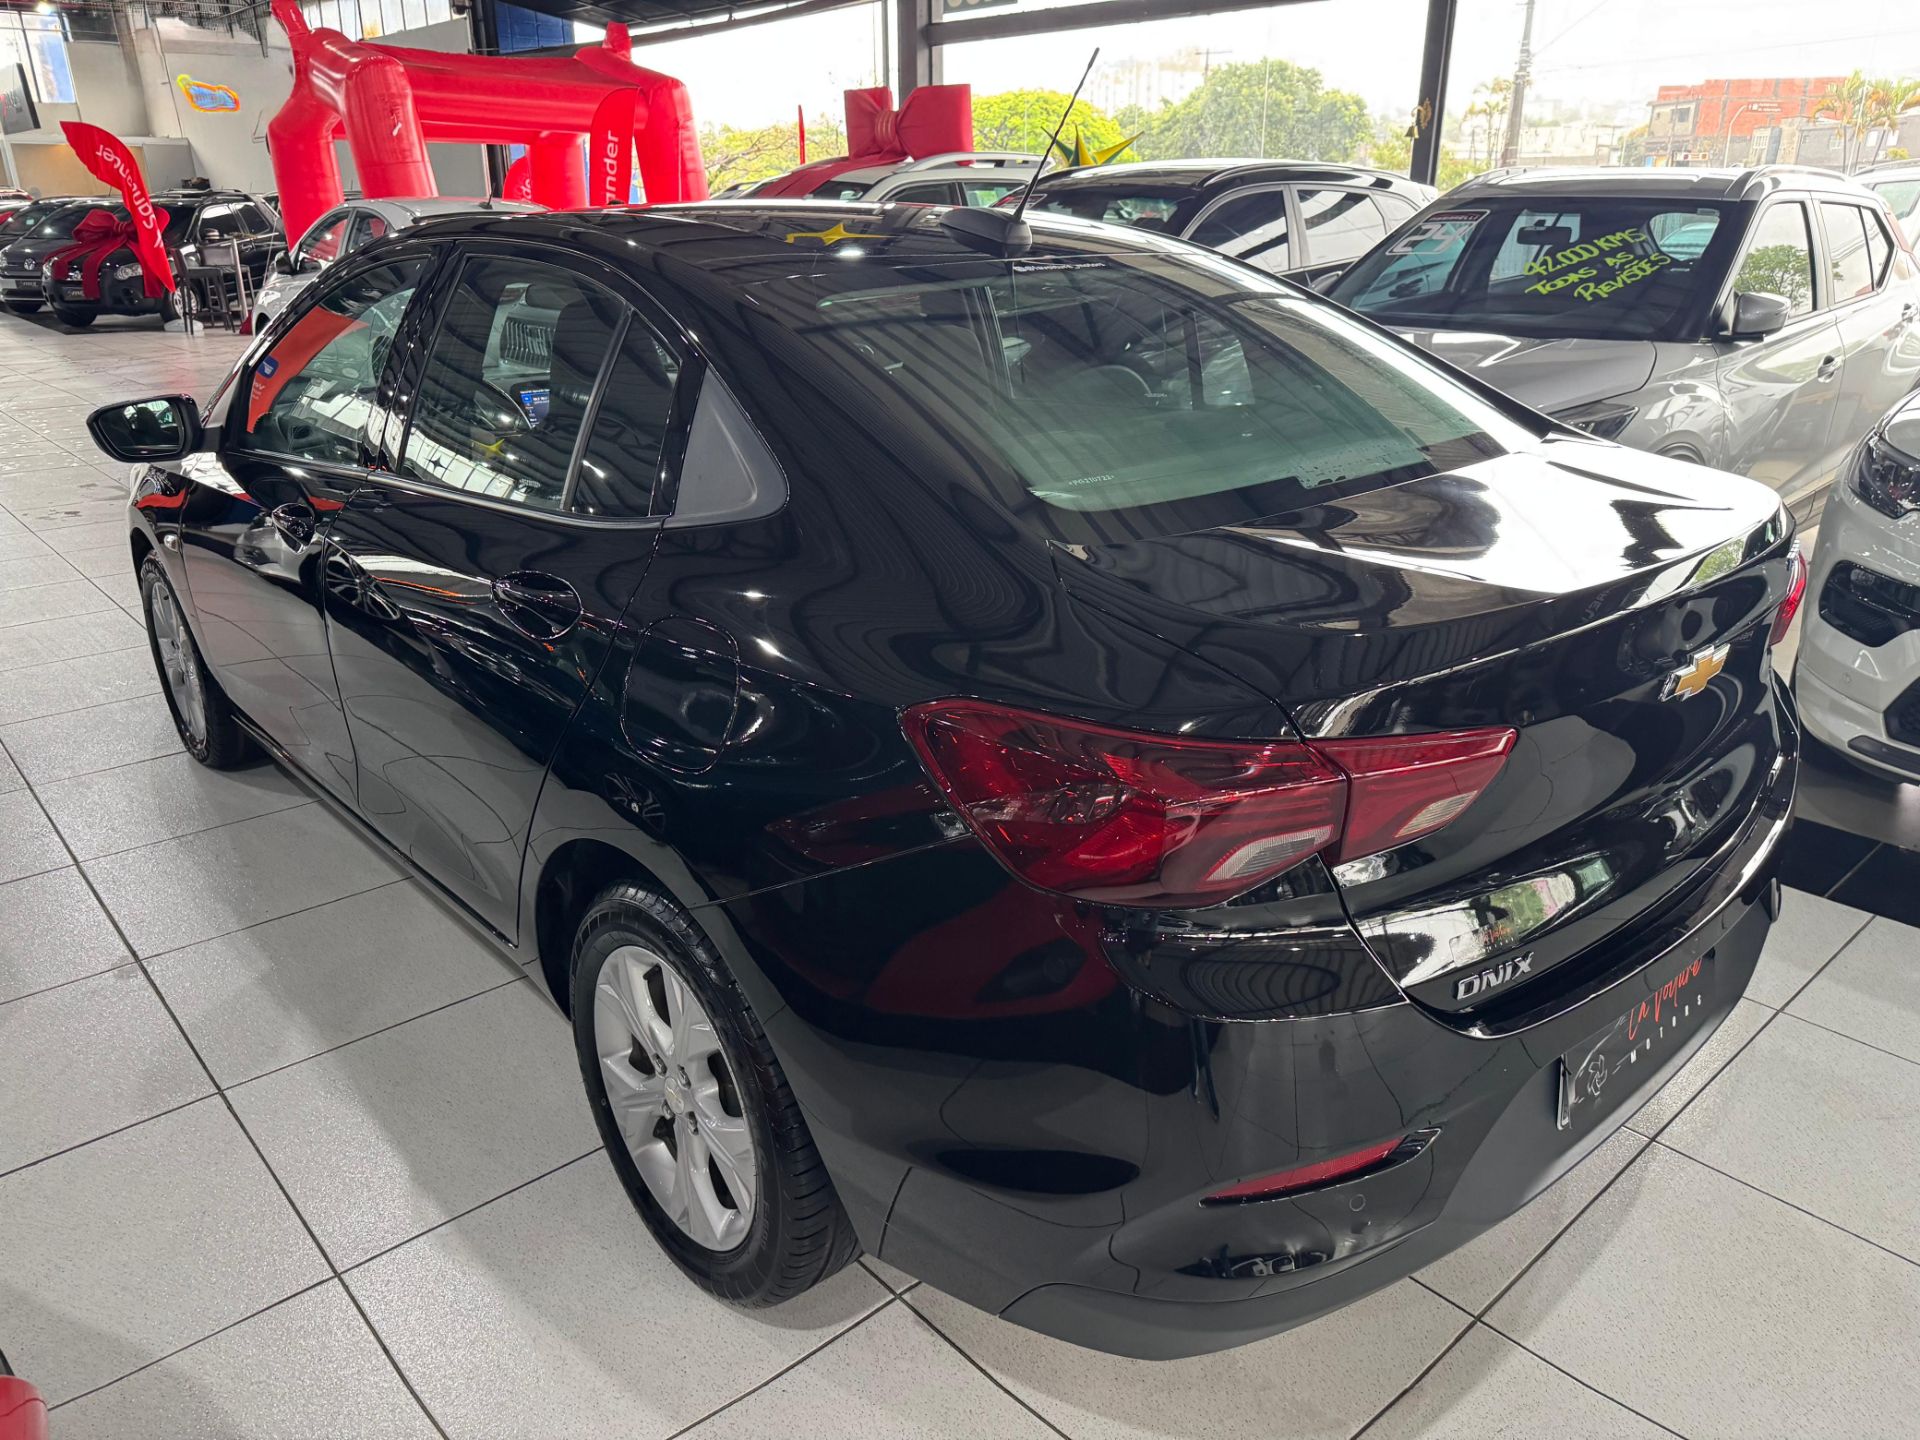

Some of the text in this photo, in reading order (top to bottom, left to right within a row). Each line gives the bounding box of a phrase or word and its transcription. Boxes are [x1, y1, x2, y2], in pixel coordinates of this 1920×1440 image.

[1523, 228, 1647, 276] 42.000 KMS
[1604, 251, 1635, 267] AS
[1456, 951, 1535, 1001] ONIX
